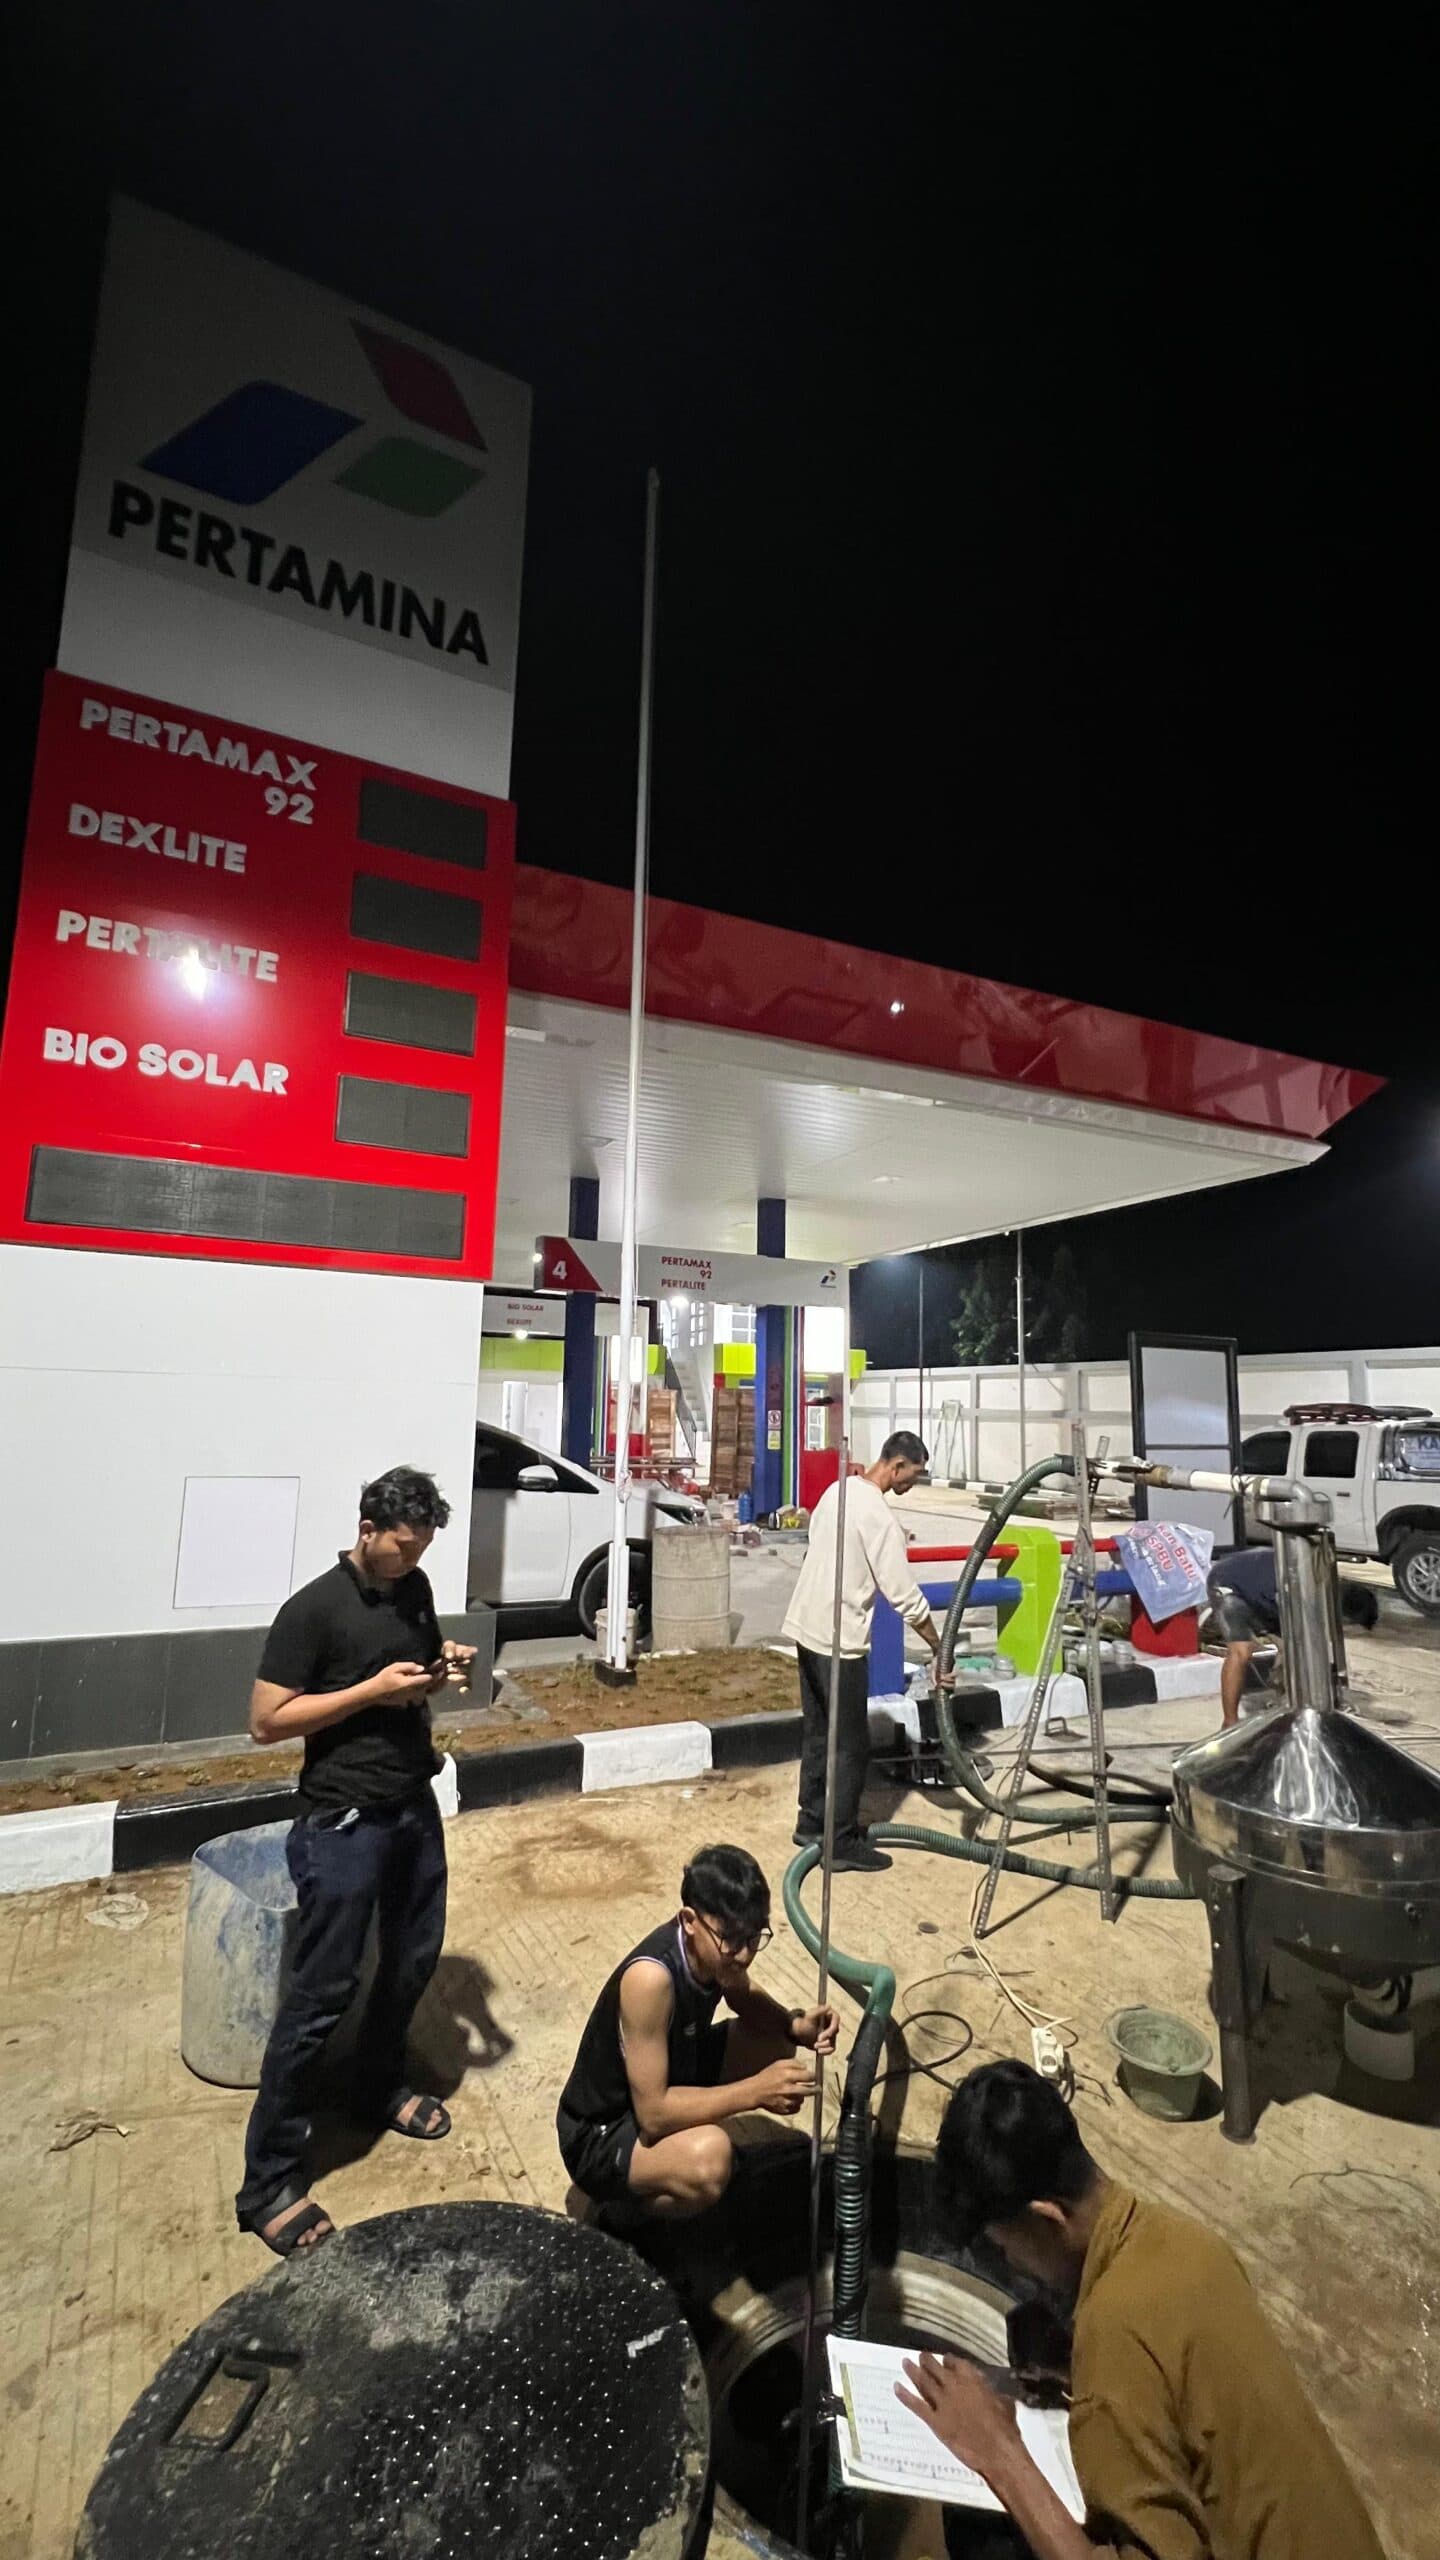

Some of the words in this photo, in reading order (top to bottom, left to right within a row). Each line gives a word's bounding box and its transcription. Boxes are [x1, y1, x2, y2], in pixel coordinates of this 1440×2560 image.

[107, 480, 488, 667] PERTAMINA
[79, 697, 319, 792] PERTAMAX
[264, 787, 314, 826] 92
[68, 803, 248, 874] DEXLITE
[43, 1027, 128, 1072] BIO
[137, 1043, 289, 1096] SOLAR
[552, 1260, 568, 1280] 4
[661, 1256, 712, 1269] PERTAMAX
[700, 1270, 712, 1280] 92
[661, 1278, 705, 1290] PERTALITE
[522, 1304, 544, 1312] SOLAR
[1146, 1535, 1174, 1572] SPBU
[1174, 1546, 1198, 1580] Batu
